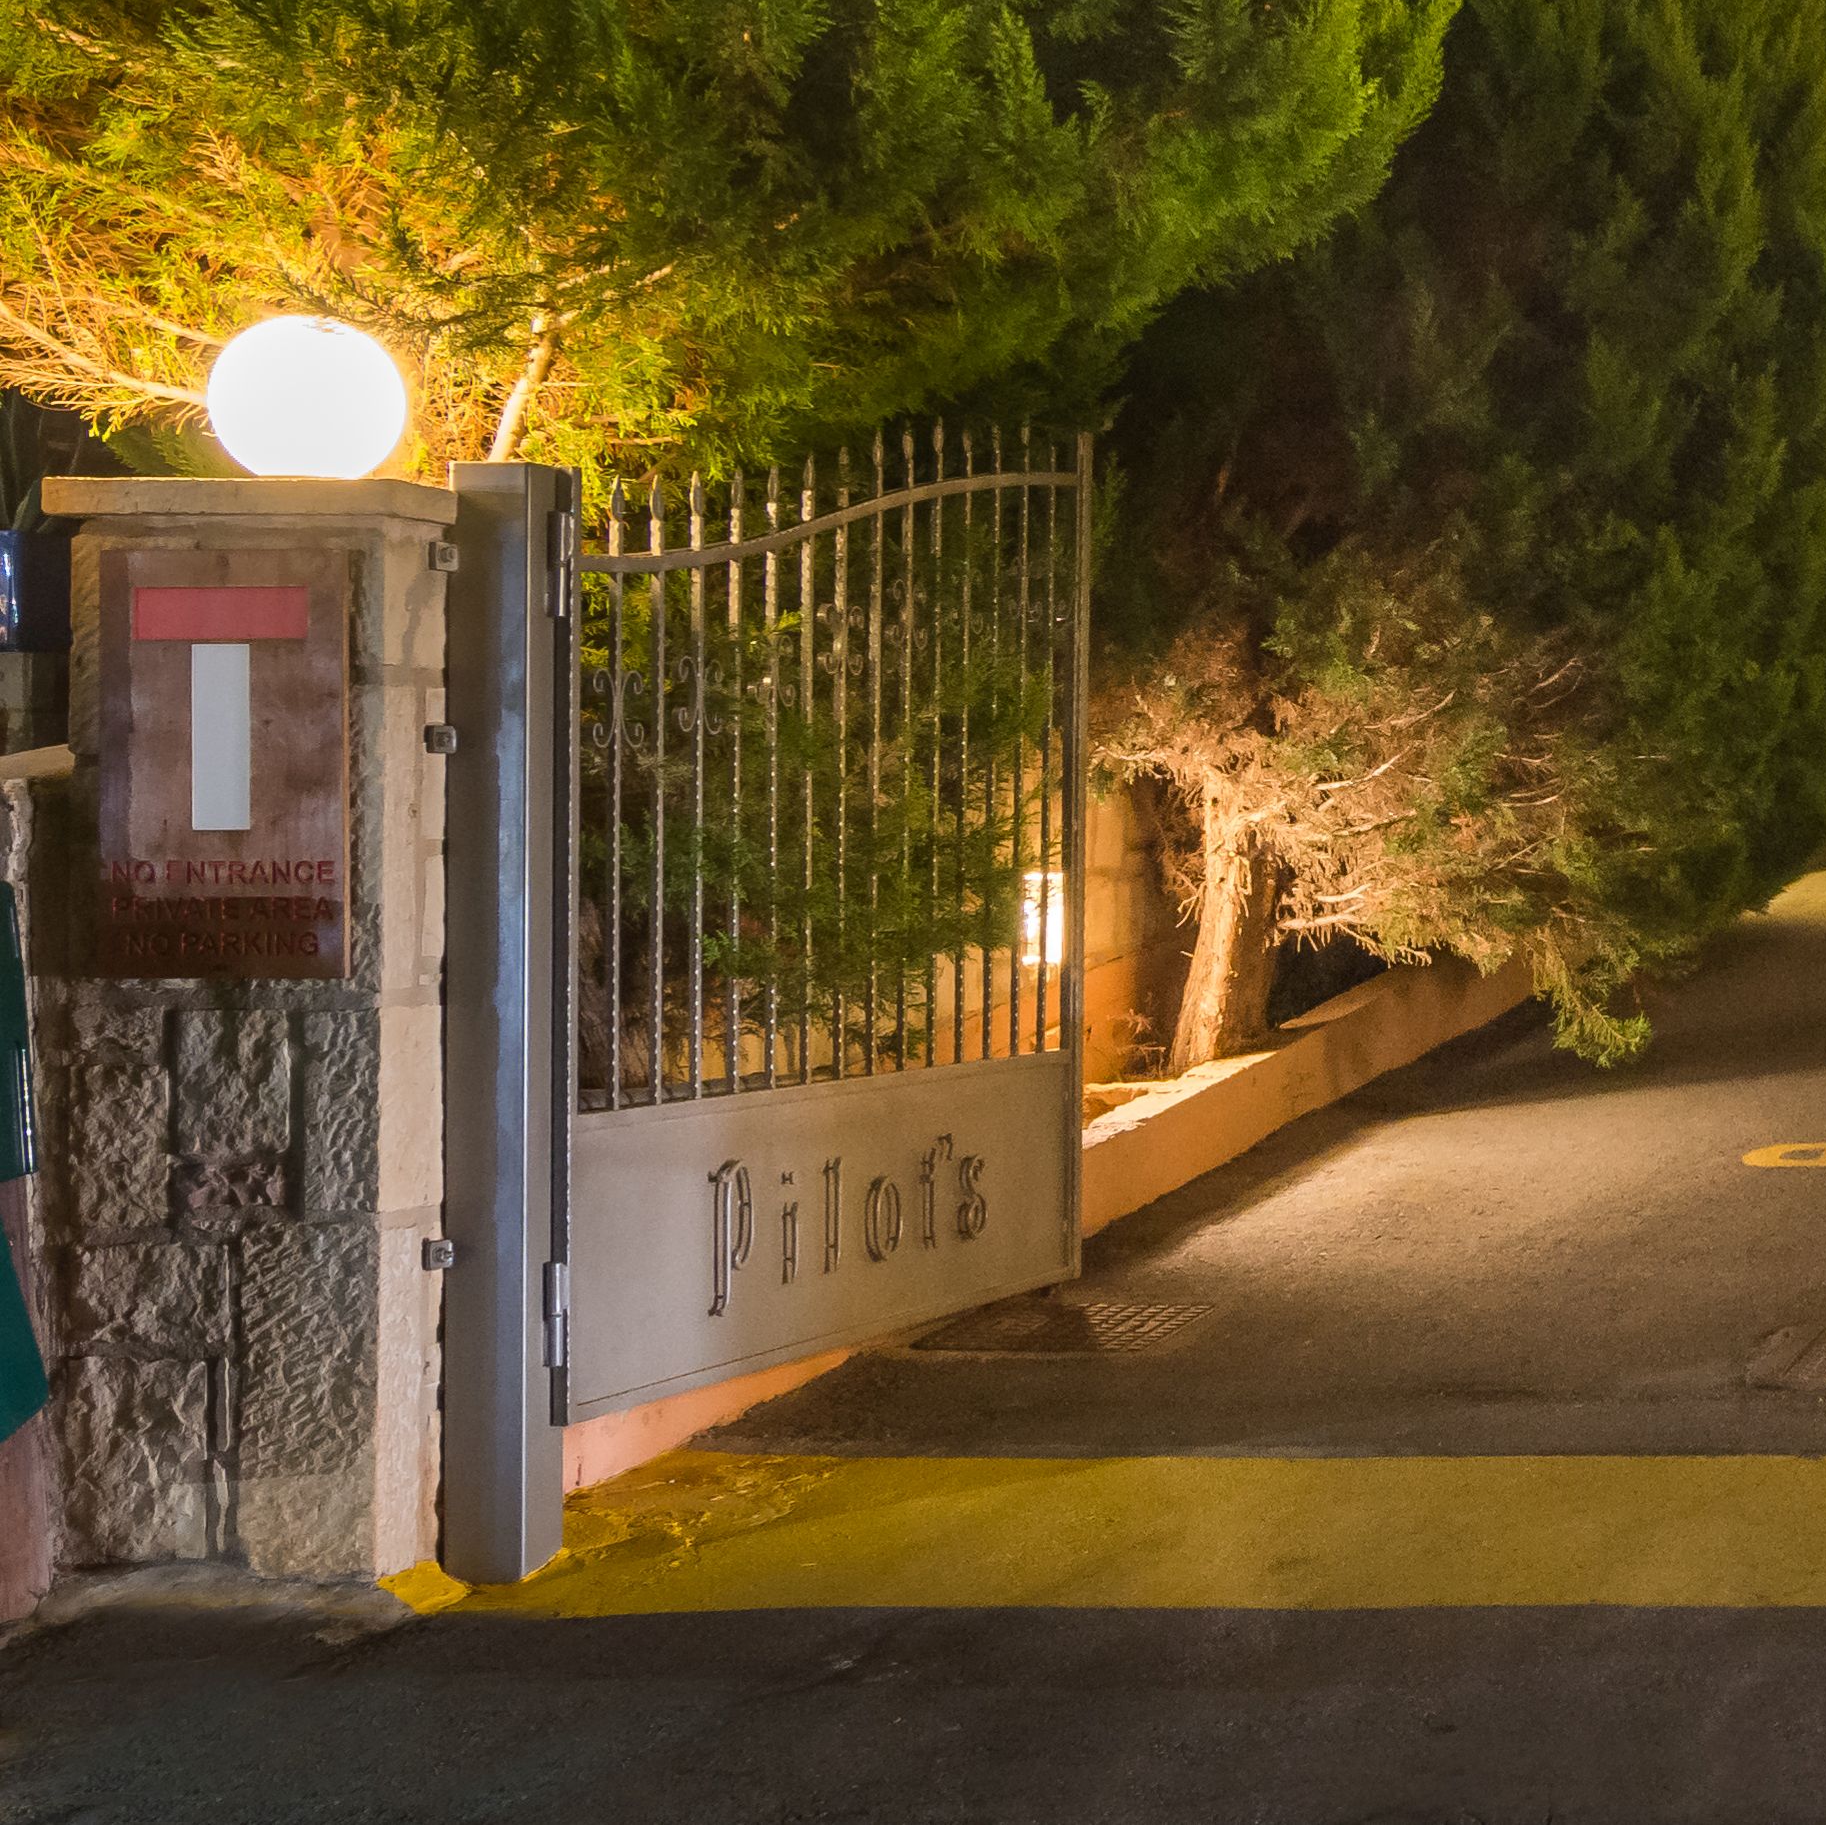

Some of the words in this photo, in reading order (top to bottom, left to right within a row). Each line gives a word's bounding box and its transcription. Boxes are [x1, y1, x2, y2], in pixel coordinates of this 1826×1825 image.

[111, 860, 155, 885] NO
[166, 860, 335, 885] ENTRANCE
[112, 896, 241, 921] PRIVATE
[250, 896, 334, 921] AREA
[125, 932, 169, 957] NO
[179, 931, 320, 957] PARKING
